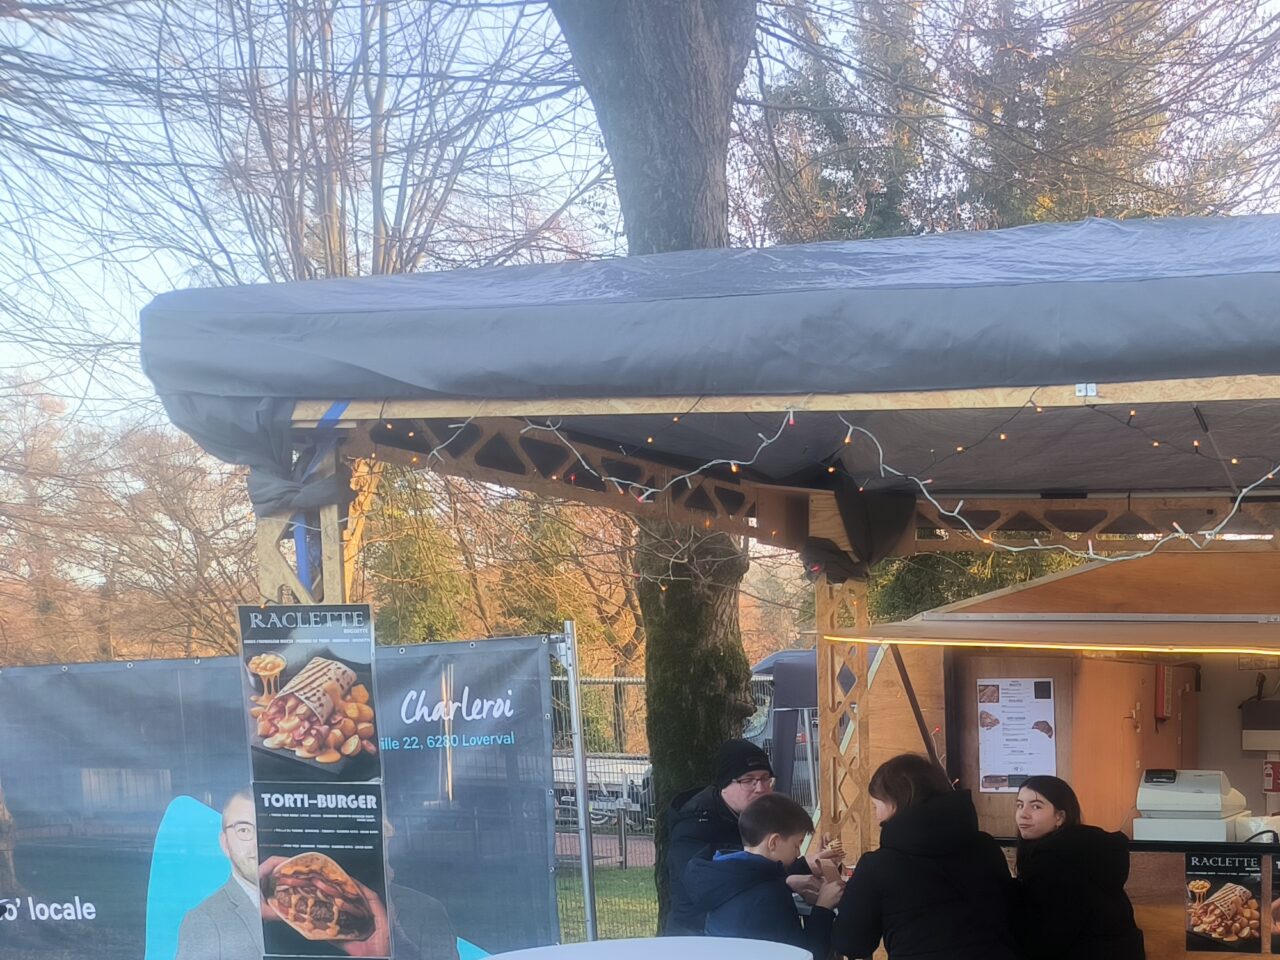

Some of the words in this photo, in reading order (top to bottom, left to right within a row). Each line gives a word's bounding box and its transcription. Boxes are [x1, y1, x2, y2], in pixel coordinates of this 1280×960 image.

[249, 612, 364, 628] RACLETTE
[400, 686, 514, 724] Charleroi
[402, 736, 423, 750] 22,
[426, 735, 458, 747] 6280
[462, 731, 515, 746] Loverval
[261, 793, 377, 808] TORTI-BURGER
[1191, 857, 1258, 866] RACLETTE
[28, 896, 96, 920] locale
